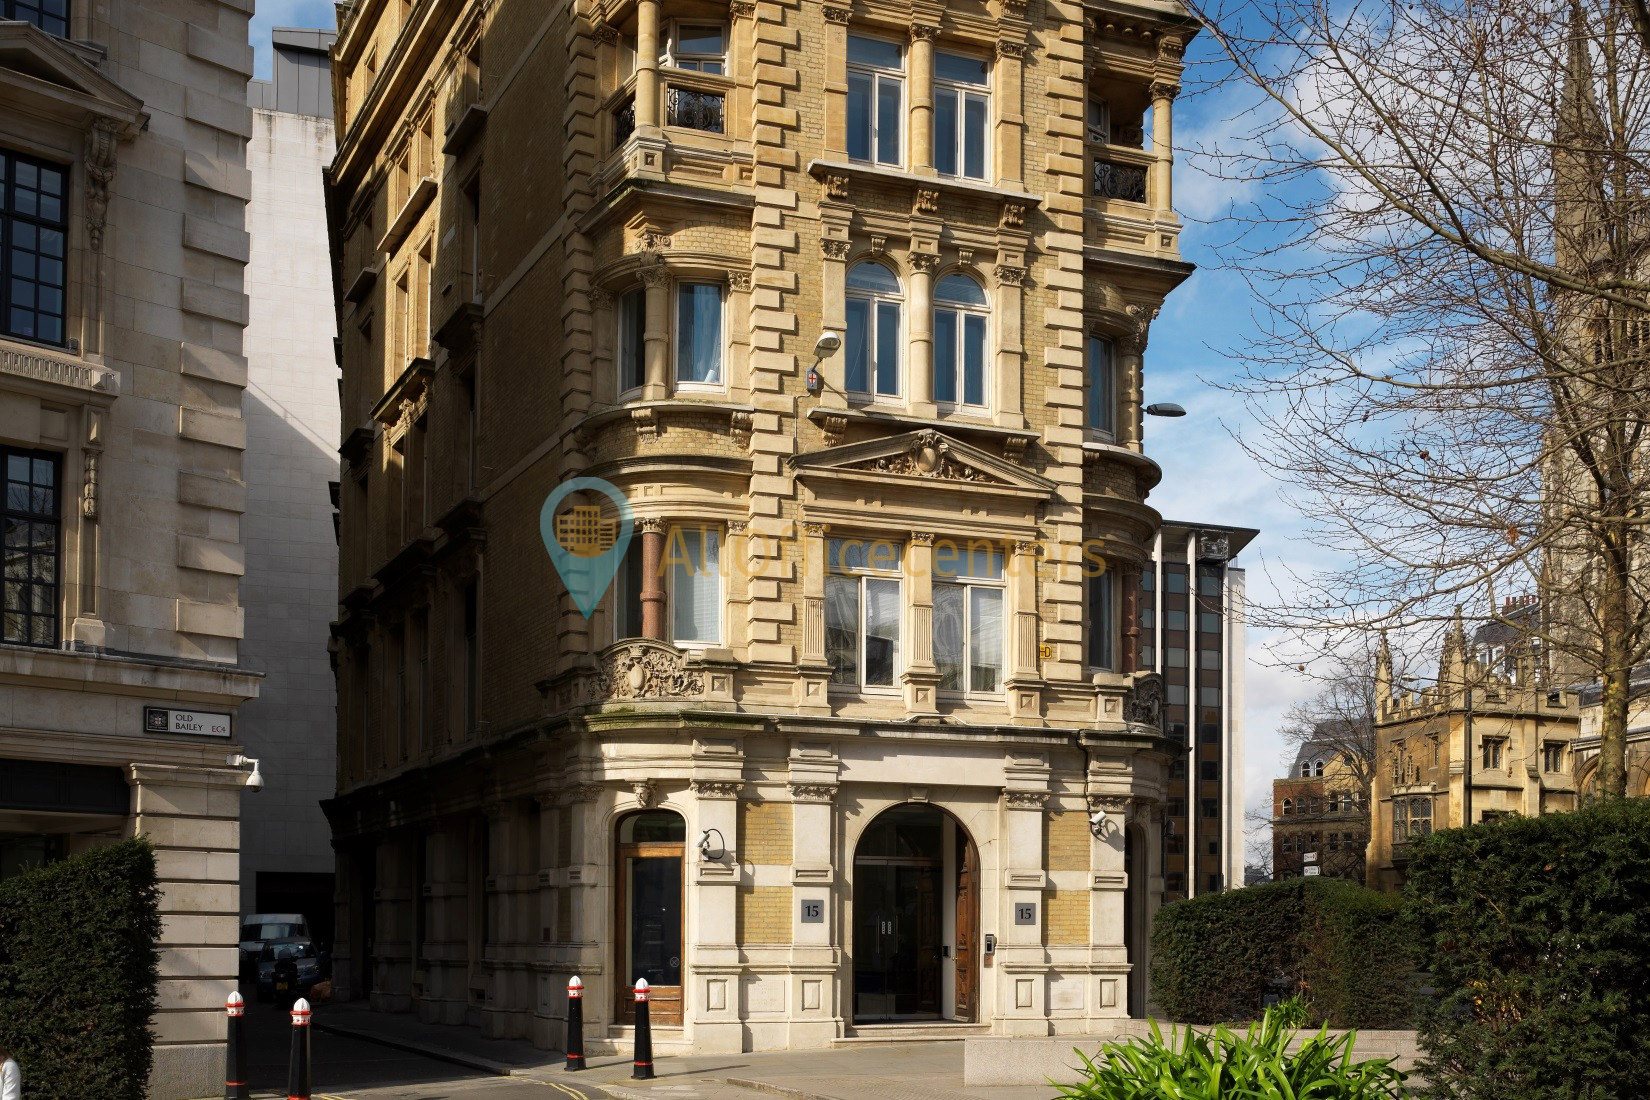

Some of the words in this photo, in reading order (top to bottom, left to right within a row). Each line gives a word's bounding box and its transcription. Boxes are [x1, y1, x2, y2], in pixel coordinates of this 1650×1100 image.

[176, 714, 194, 722] OLD
[176, 722, 204, 732] BAILEY
[211, 725, 226, 733] EC4
[805, 905, 819, 917] 15
[1018, 908, 1031, 920] 15
